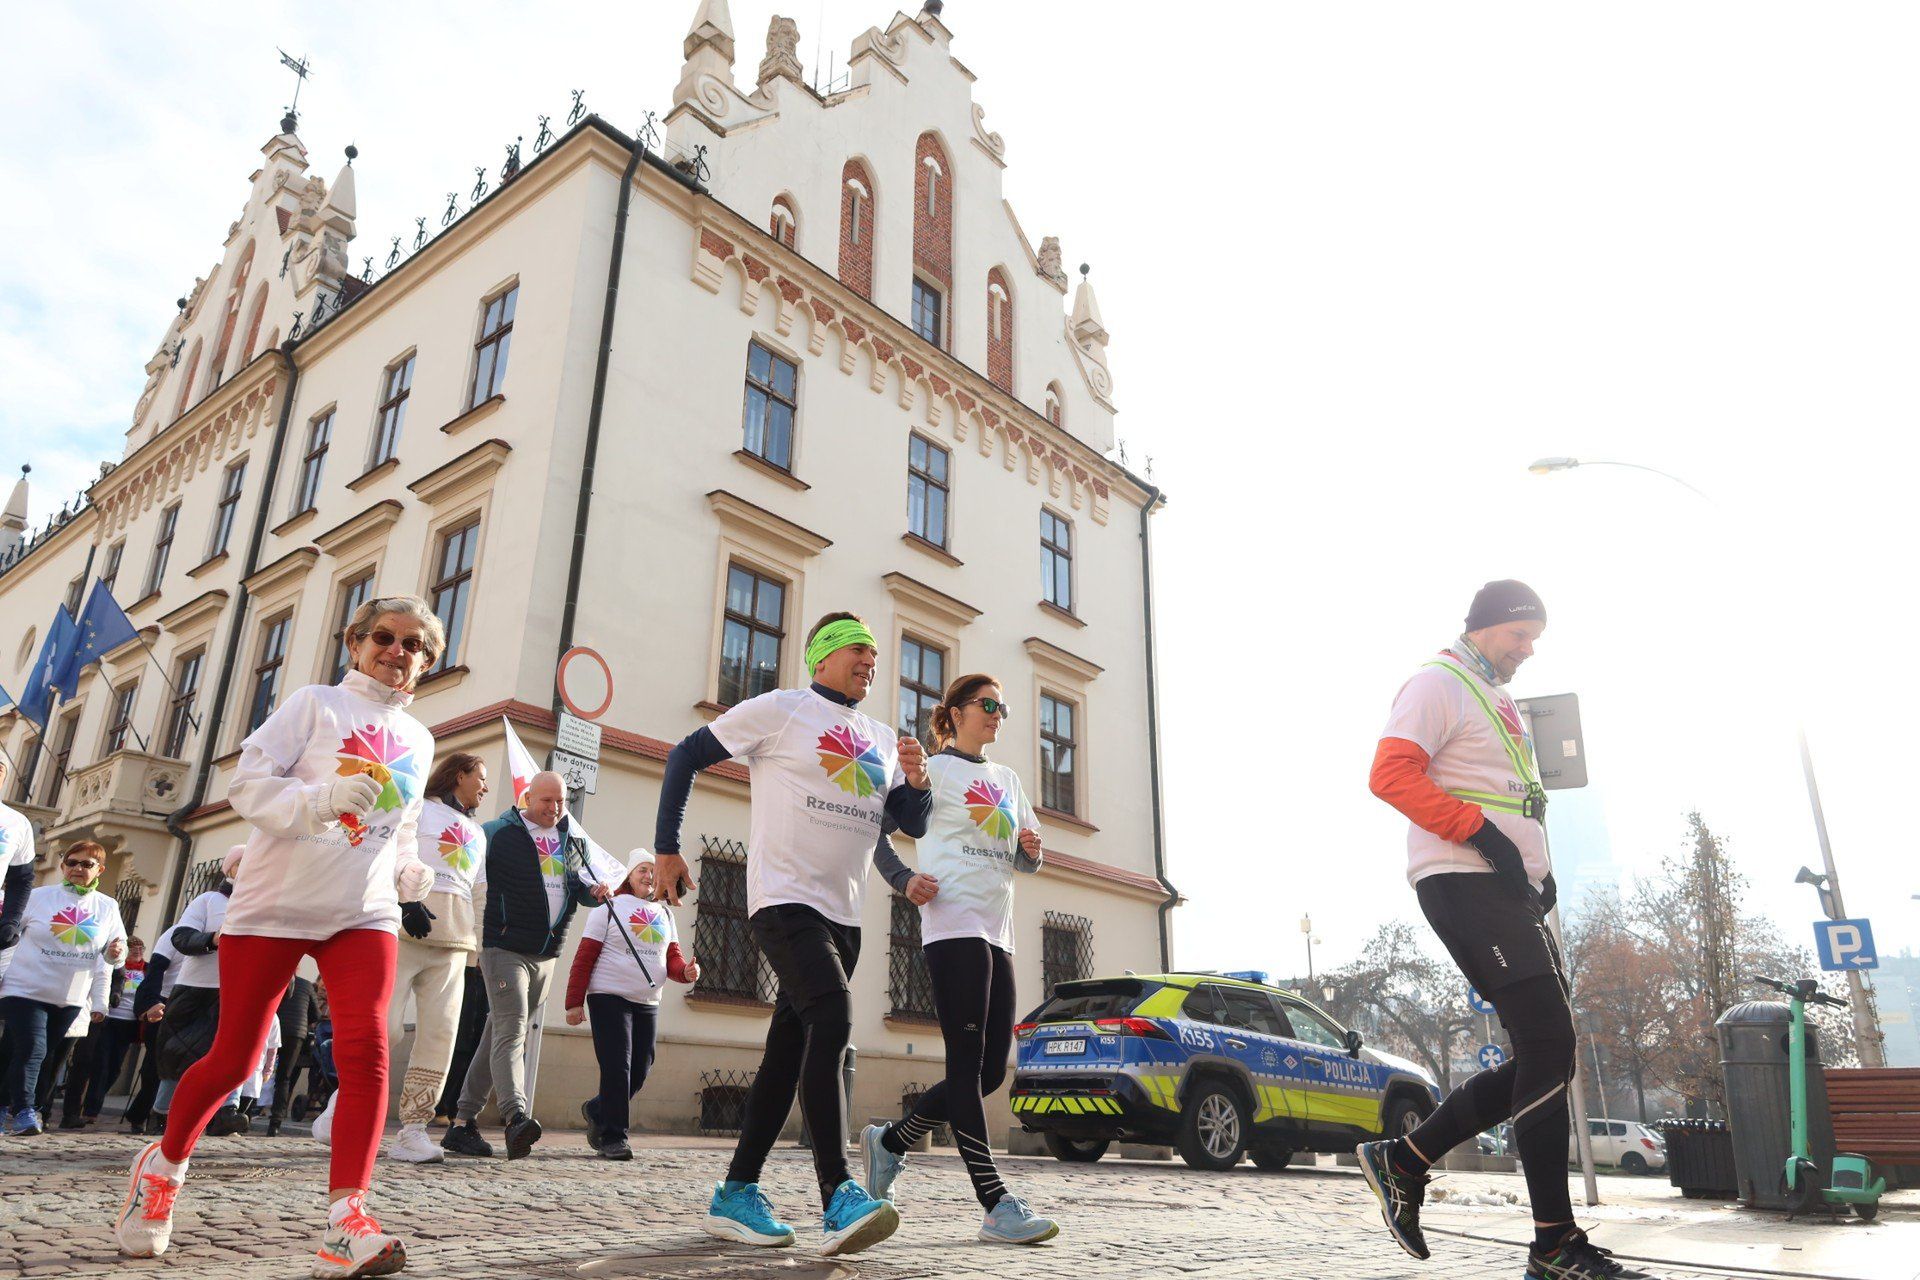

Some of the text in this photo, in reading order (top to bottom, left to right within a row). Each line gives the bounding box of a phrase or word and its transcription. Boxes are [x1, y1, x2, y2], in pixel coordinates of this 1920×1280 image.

[555, 752, 597, 773] Nie dotyczy
[805, 795, 867, 820] Rzeszów
[1827, 925, 1862, 964] P
[1048, 1041, 1083, 1053] HPK R147
[1100, 1036, 1115, 1045] K155
[1178, 1025, 1215, 1049] K155
[1324, 1060, 1372, 1085] POLICJA
